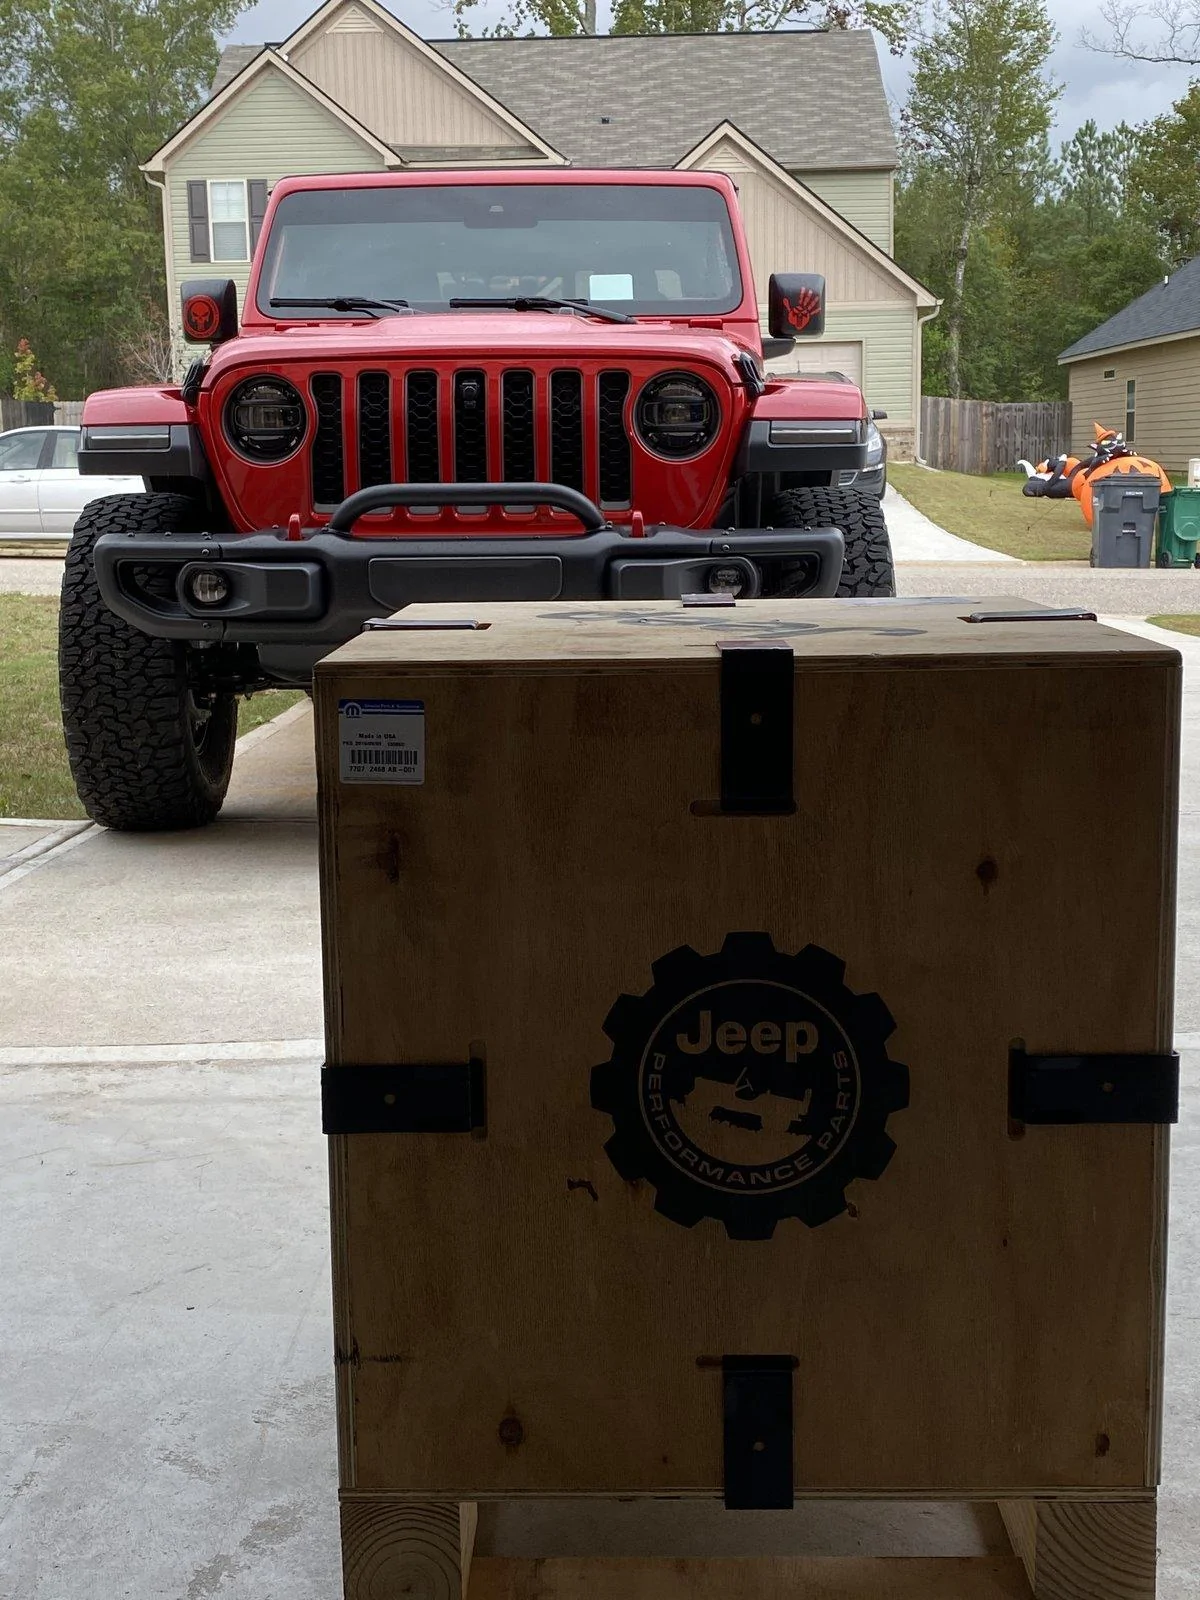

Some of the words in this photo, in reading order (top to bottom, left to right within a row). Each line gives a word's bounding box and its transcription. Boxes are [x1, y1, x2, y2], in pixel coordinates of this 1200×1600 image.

[676, 1010, 819, 1063] Jeep
[648, 1052, 815, 1186] PERFORMANCE
[816, 1050, 851, 1151] PARTS
